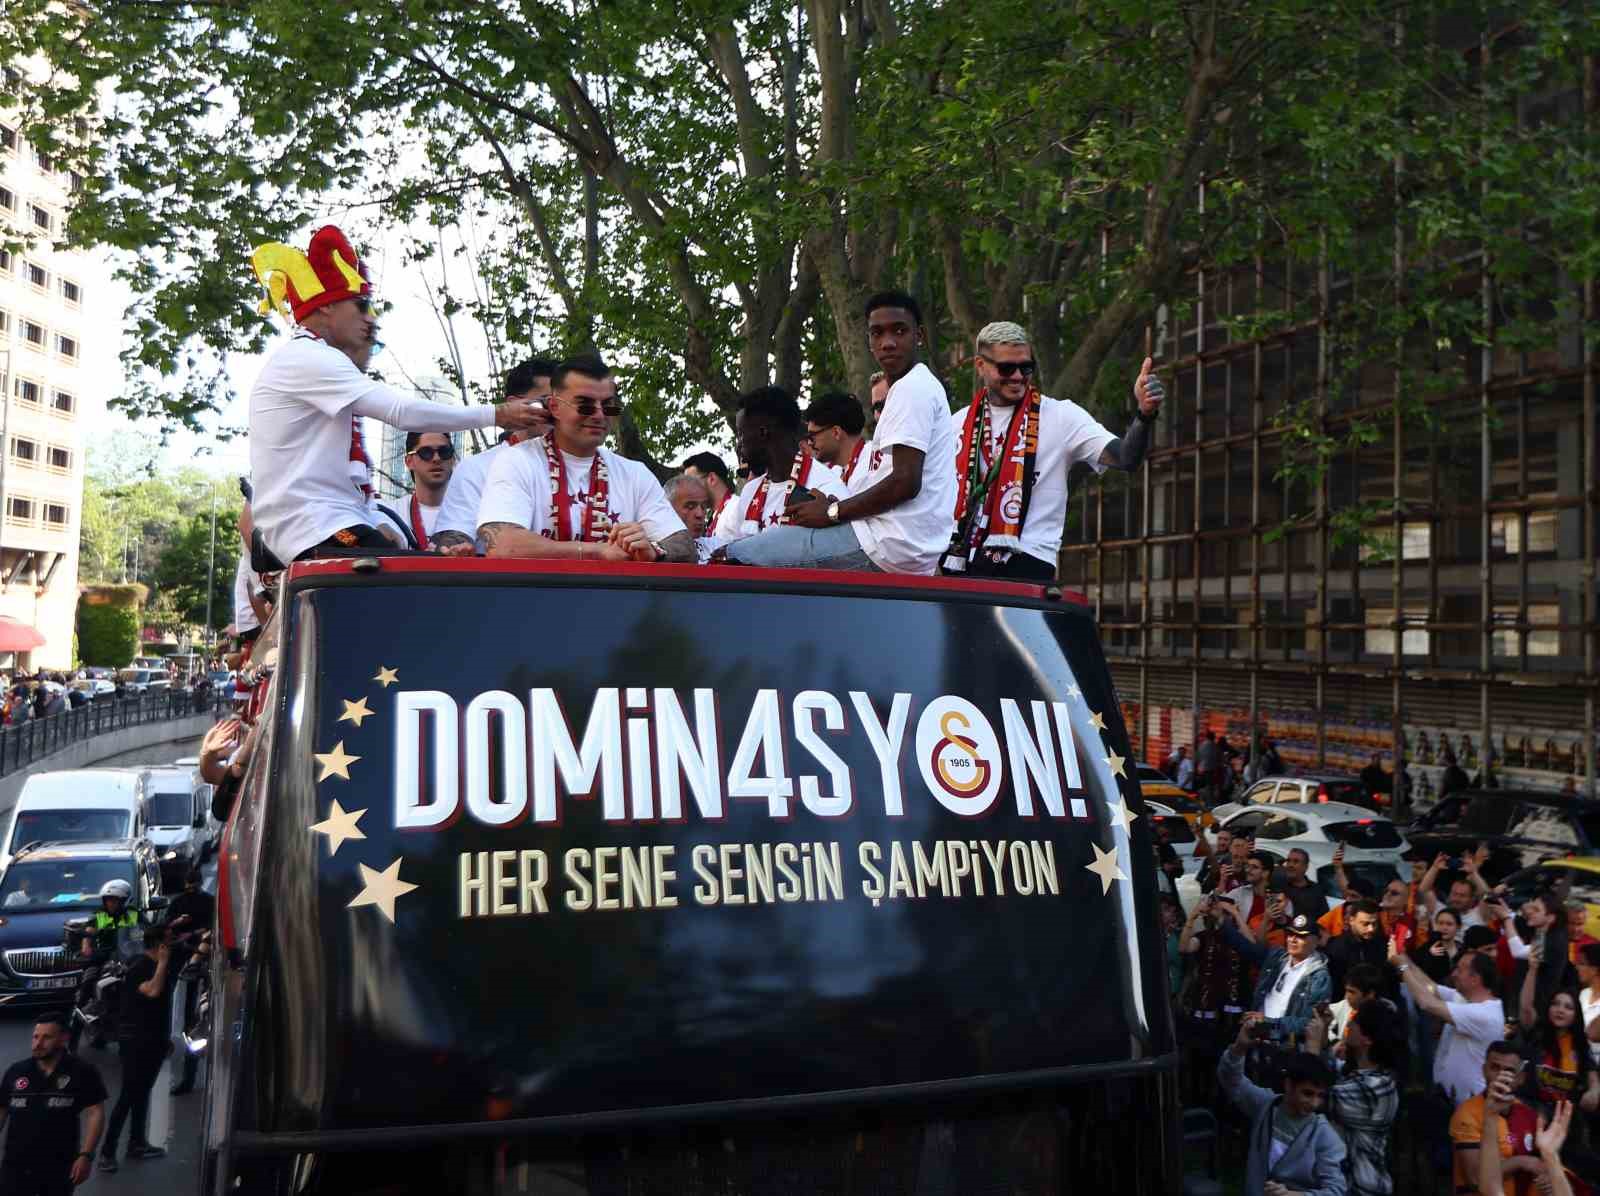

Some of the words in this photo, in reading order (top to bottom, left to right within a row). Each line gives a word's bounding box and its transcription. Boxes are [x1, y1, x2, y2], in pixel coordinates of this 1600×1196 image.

[949, 759, 971, 769] 1905
[458, 851, 550, 919] HER
[565, 845, 679, 911] SENE
